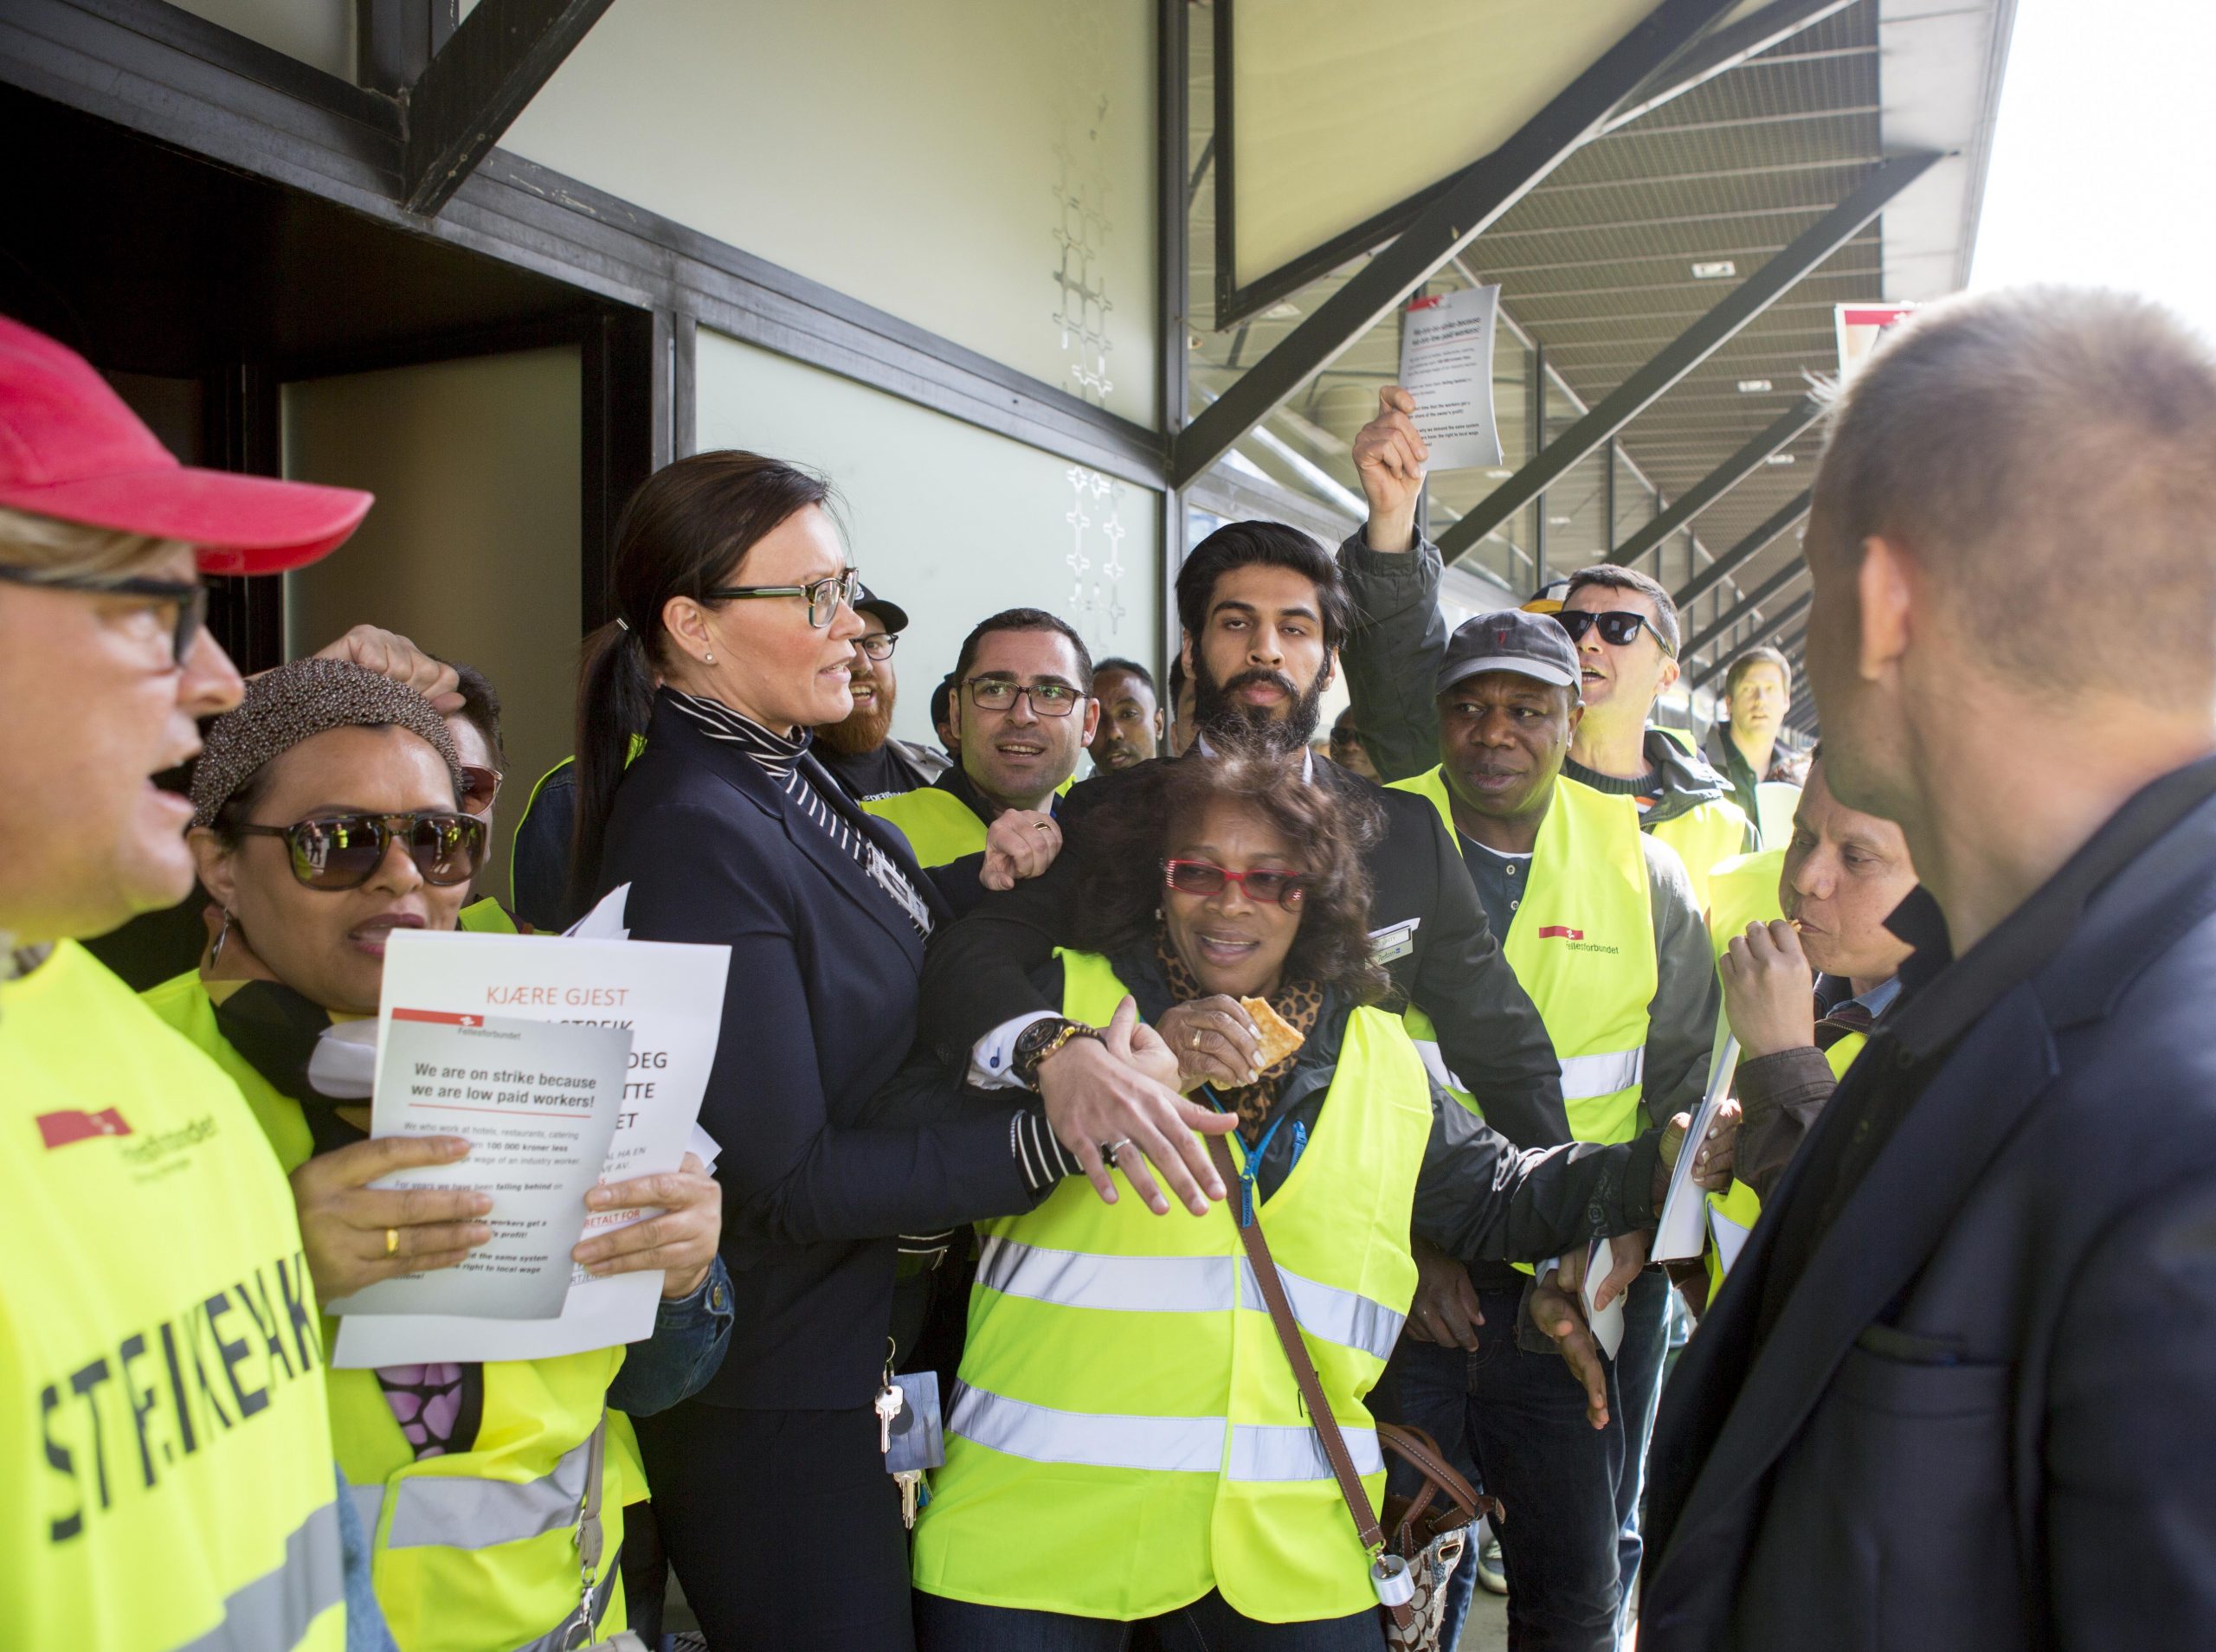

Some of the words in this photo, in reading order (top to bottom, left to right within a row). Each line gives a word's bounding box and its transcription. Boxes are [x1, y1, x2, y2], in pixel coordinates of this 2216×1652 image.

[486, 986, 557, 1005] KJÆRE
[565, 988, 629, 1006] GJEST
[415, 1063, 436, 1077] We
[441, 1067, 465, 1079] are
[470, 1069, 488, 1080] on
[493, 1070, 534, 1084] strike
[538, 1073, 596, 1090] because
[411, 1084, 432, 1096] we
[438, 1087, 461, 1098] are
[467, 1086, 492, 1101] low
[497, 1090, 528, 1104] paid
[534, 1094, 595, 1108] workers!
[439, 1124, 459, 1134] work
[522, 1142, 550, 1152] kroner
[552, 1143, 568, 1152] less
[496, 1182, 522, 1192] falling
[525, 1182, 551, 1192] behind
[622, 1210, 641, 1221] FOR
[479, 1251, 493, 1260] the
[519, 1253, 549, 1263] system
[462, 1263, 484, 1272] right
[497, 1264, 517, 1273] local
[519, 1265, 541, 1275] wage
